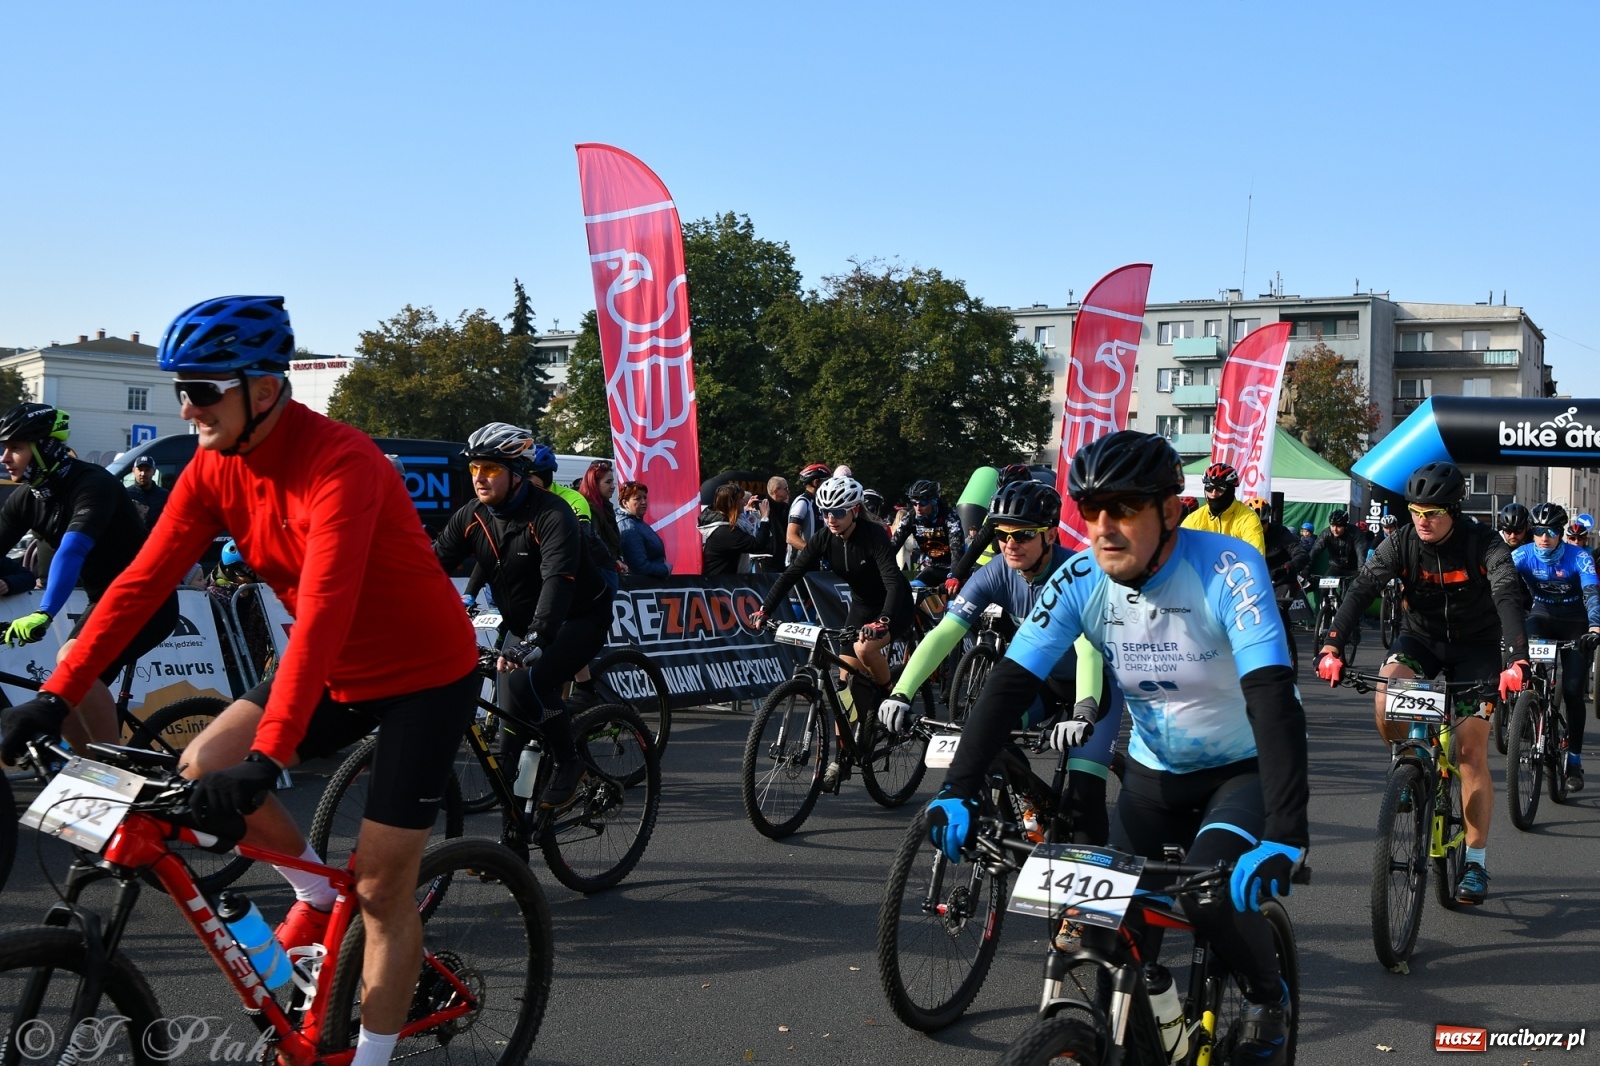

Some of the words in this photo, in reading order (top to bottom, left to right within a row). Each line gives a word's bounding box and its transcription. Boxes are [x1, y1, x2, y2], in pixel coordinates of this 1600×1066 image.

[1499, 421, 1557, 447] bike
[1366, 499, 1382, 537] elier
[1031, 555, 1093, 630] SCHC
[1213, 550, 1262, 632] SCHC
[475, 617, 498, 625] 1413
[607, 588, 766, 645] REZADO
[1160, 607, 1191, 615] Chrzanów
[784, 624, 812, 637] 2341
[175, 640, 204, 650] jedziesz
[1122, 642, 1178, 653] SEPPELER
[1530, 647, 1549, 655] 158
[1123, 653, 1184, 663] OCYNKOWNIA
[1186, 649, 1219, 663] ŚLĄSK
[606, 664, 706, 699] USZCZNIAMY
[706, 656, 786, 690] NAJLEPSZYCH
[1125, 662, 1177, 673] CHRZANÓW
[1396, 696, 1436, 711] 2392
[50, 788, 112, 826] 1132
[1037, 869, 1114, 900] 1410
[186, 894, 271, 1008] TREK
